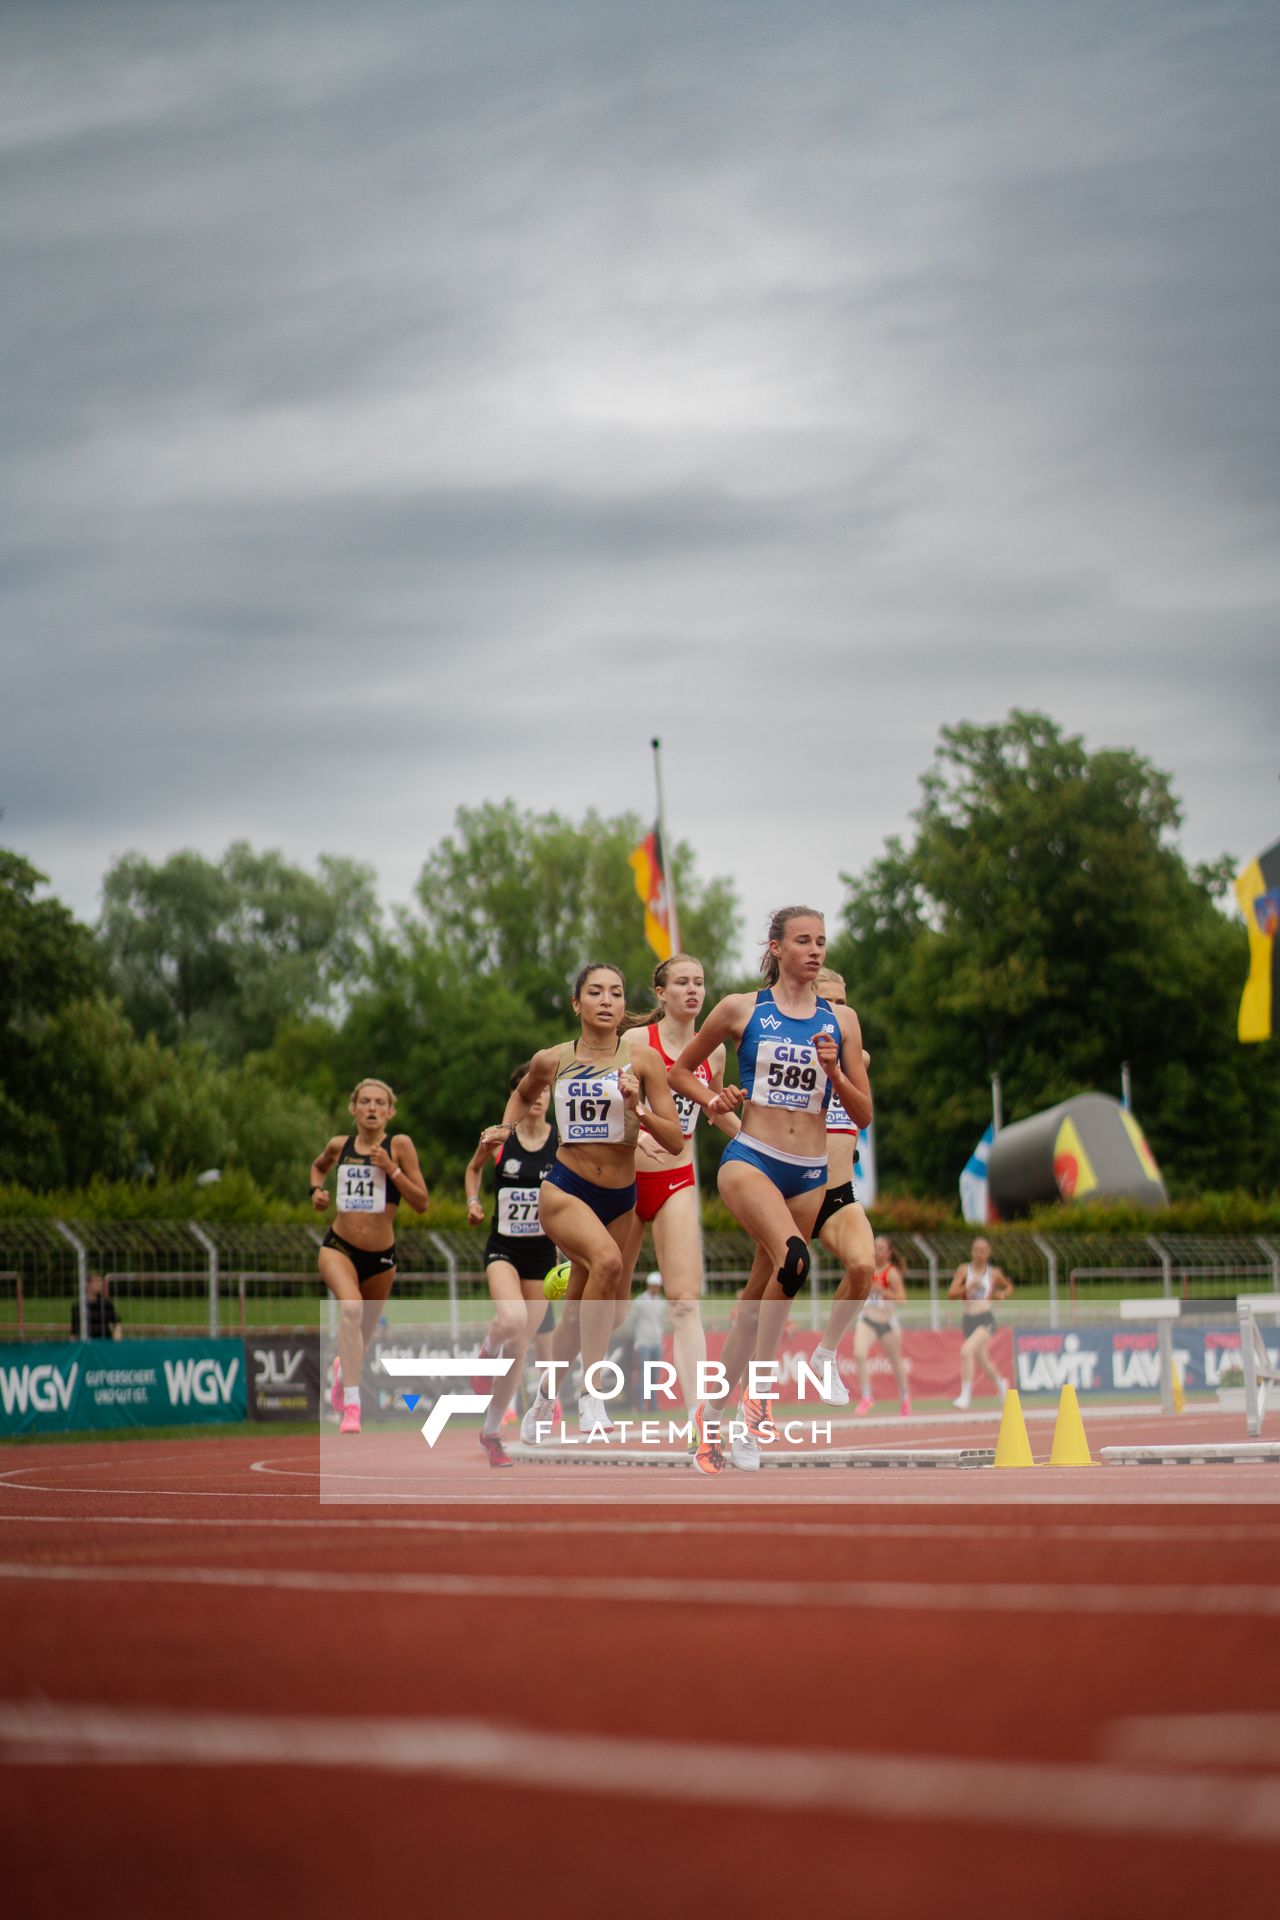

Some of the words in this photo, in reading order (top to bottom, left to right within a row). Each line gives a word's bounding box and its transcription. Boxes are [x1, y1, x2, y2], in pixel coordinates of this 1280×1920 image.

[767, 1062, 817, 1091] 589
[785, 1094, 808, 1104] PLAN
[565, 1098, 611, 1121] 167
[584, 1126, 608, 1134] PLAN
[347, 1167, 371, 1178] GLS
[344, 1181, 374, 1197] 141
[510, 1191, 537, 1202] GLS
[0, 1361, 79, 1416] WGV
[163, 1357, 240, 1406] WGV
